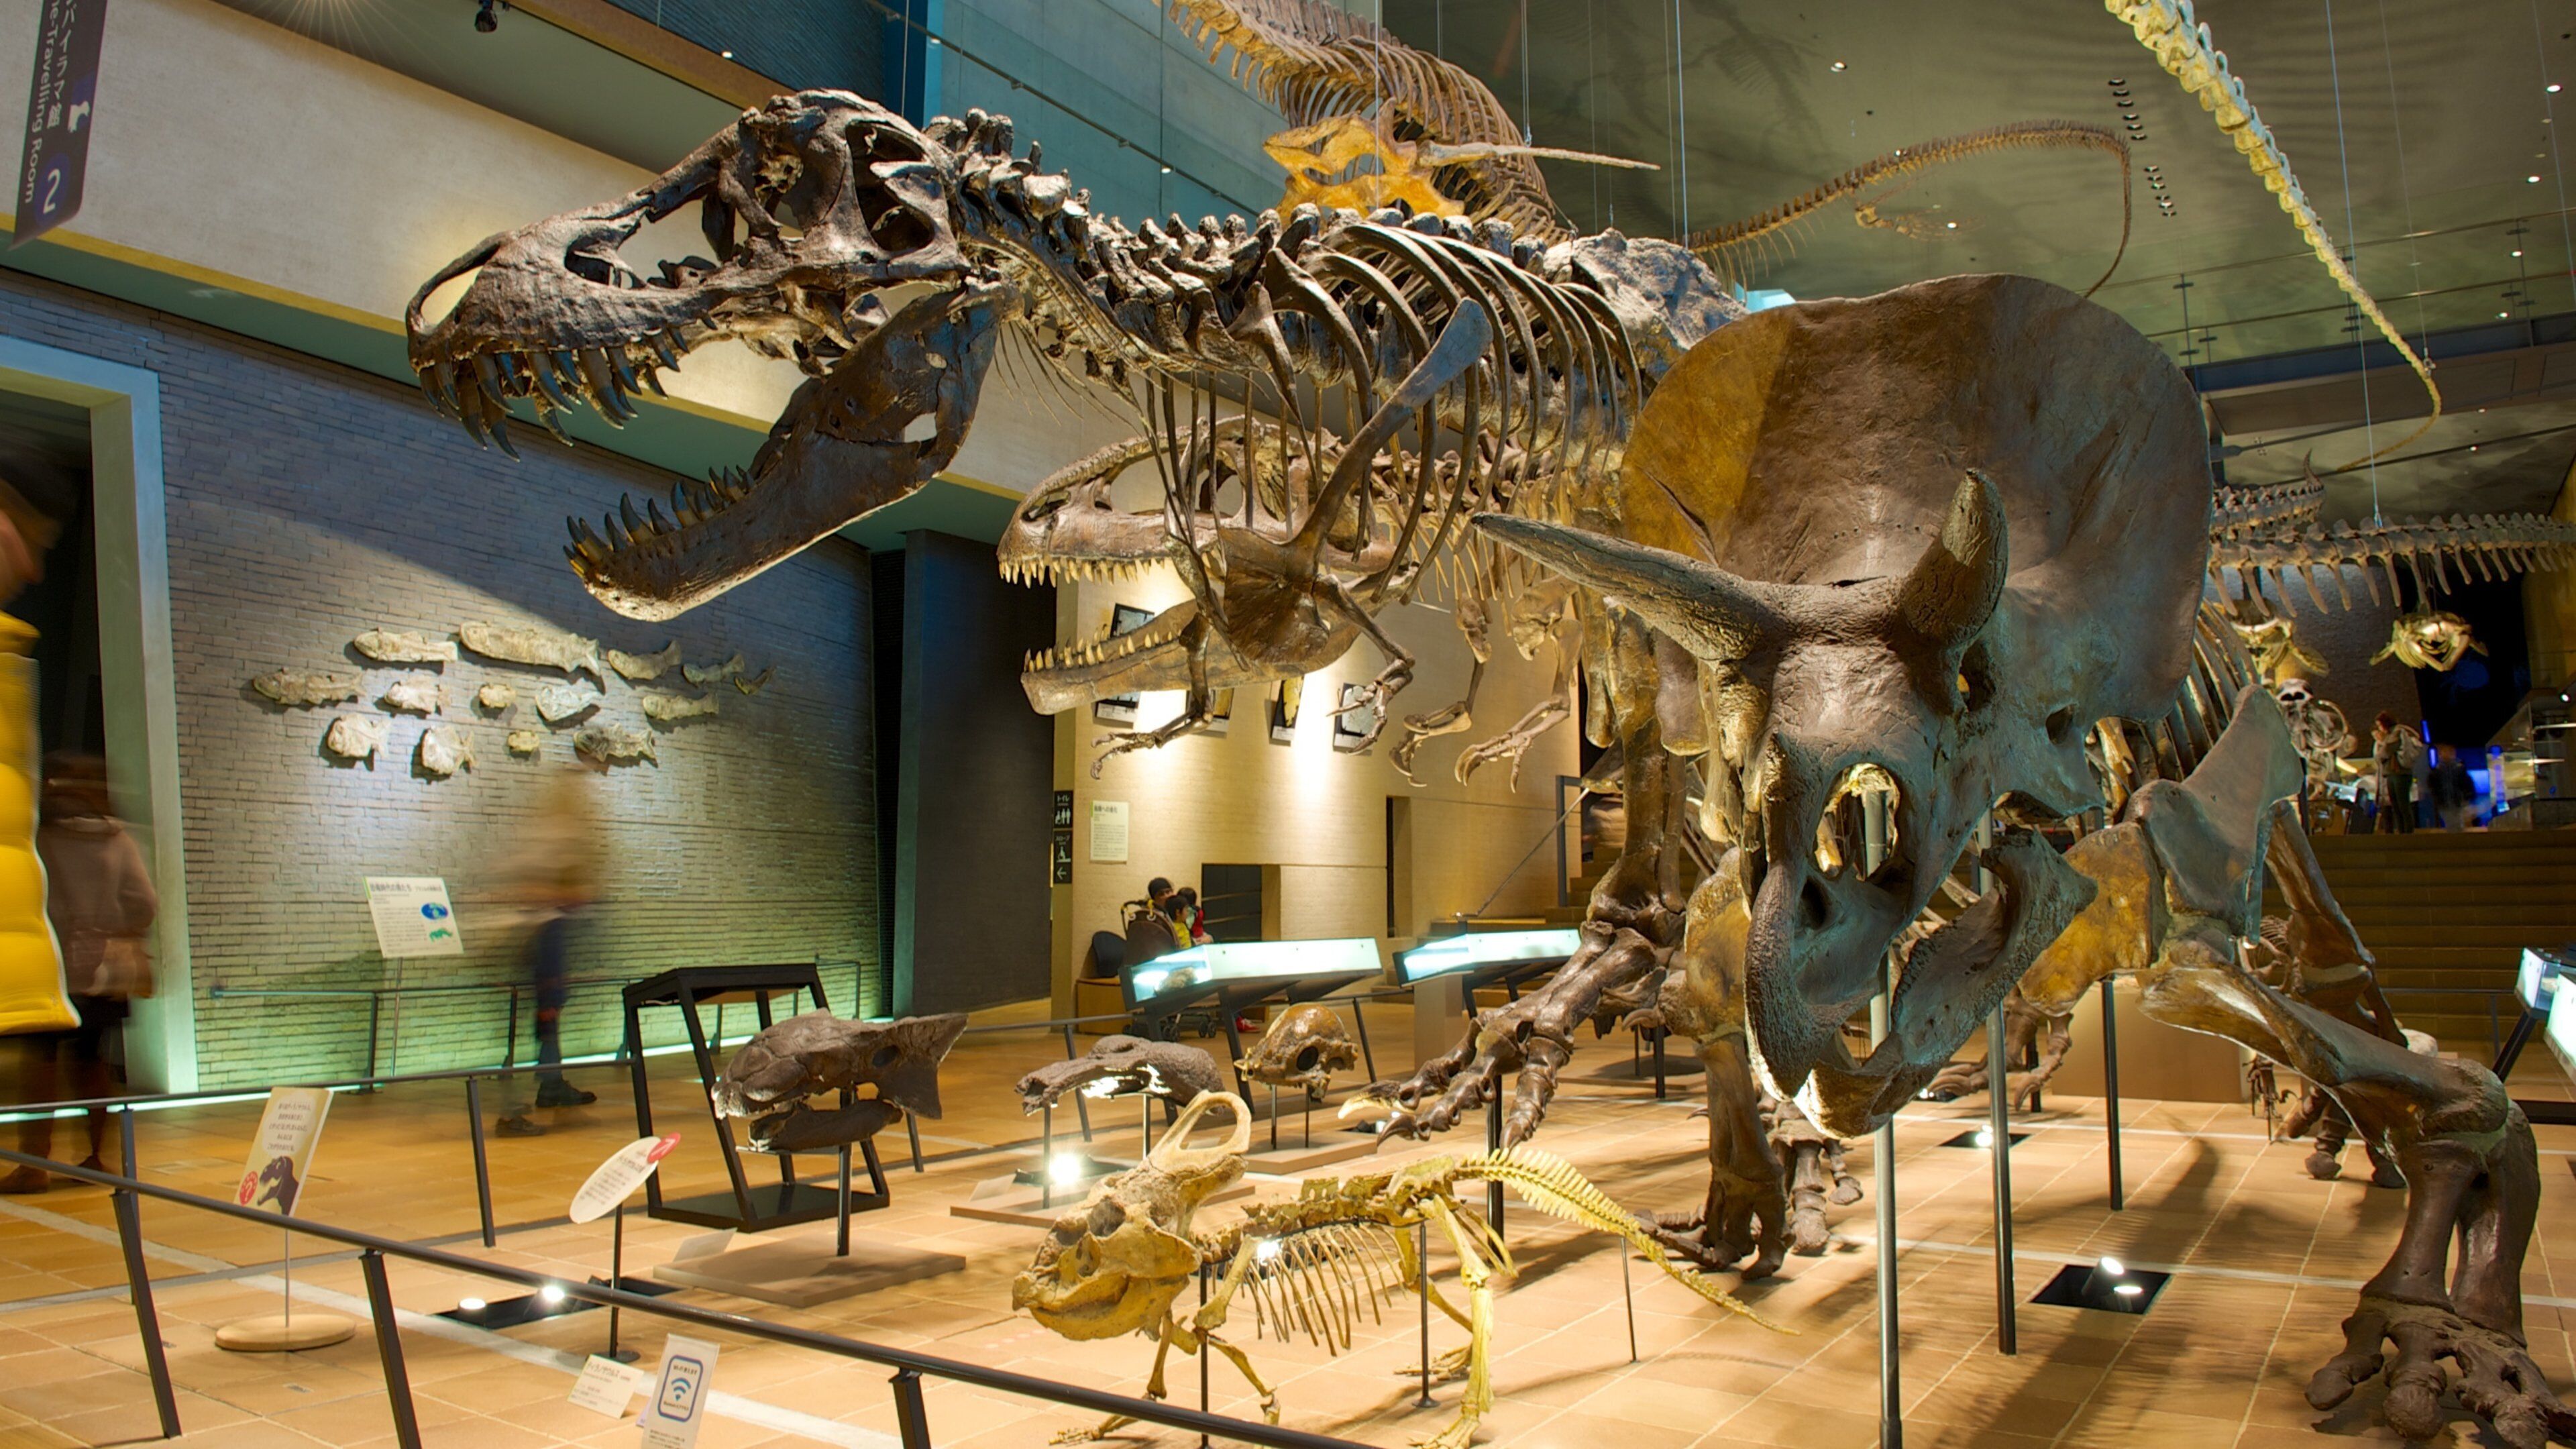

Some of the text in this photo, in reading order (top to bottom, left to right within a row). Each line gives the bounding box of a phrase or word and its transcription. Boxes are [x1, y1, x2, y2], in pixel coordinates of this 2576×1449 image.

[48, 0, 77, 128] バイラマ館
[25, 138, 42, 203] Room
[43, 168, 61, 214] 2
